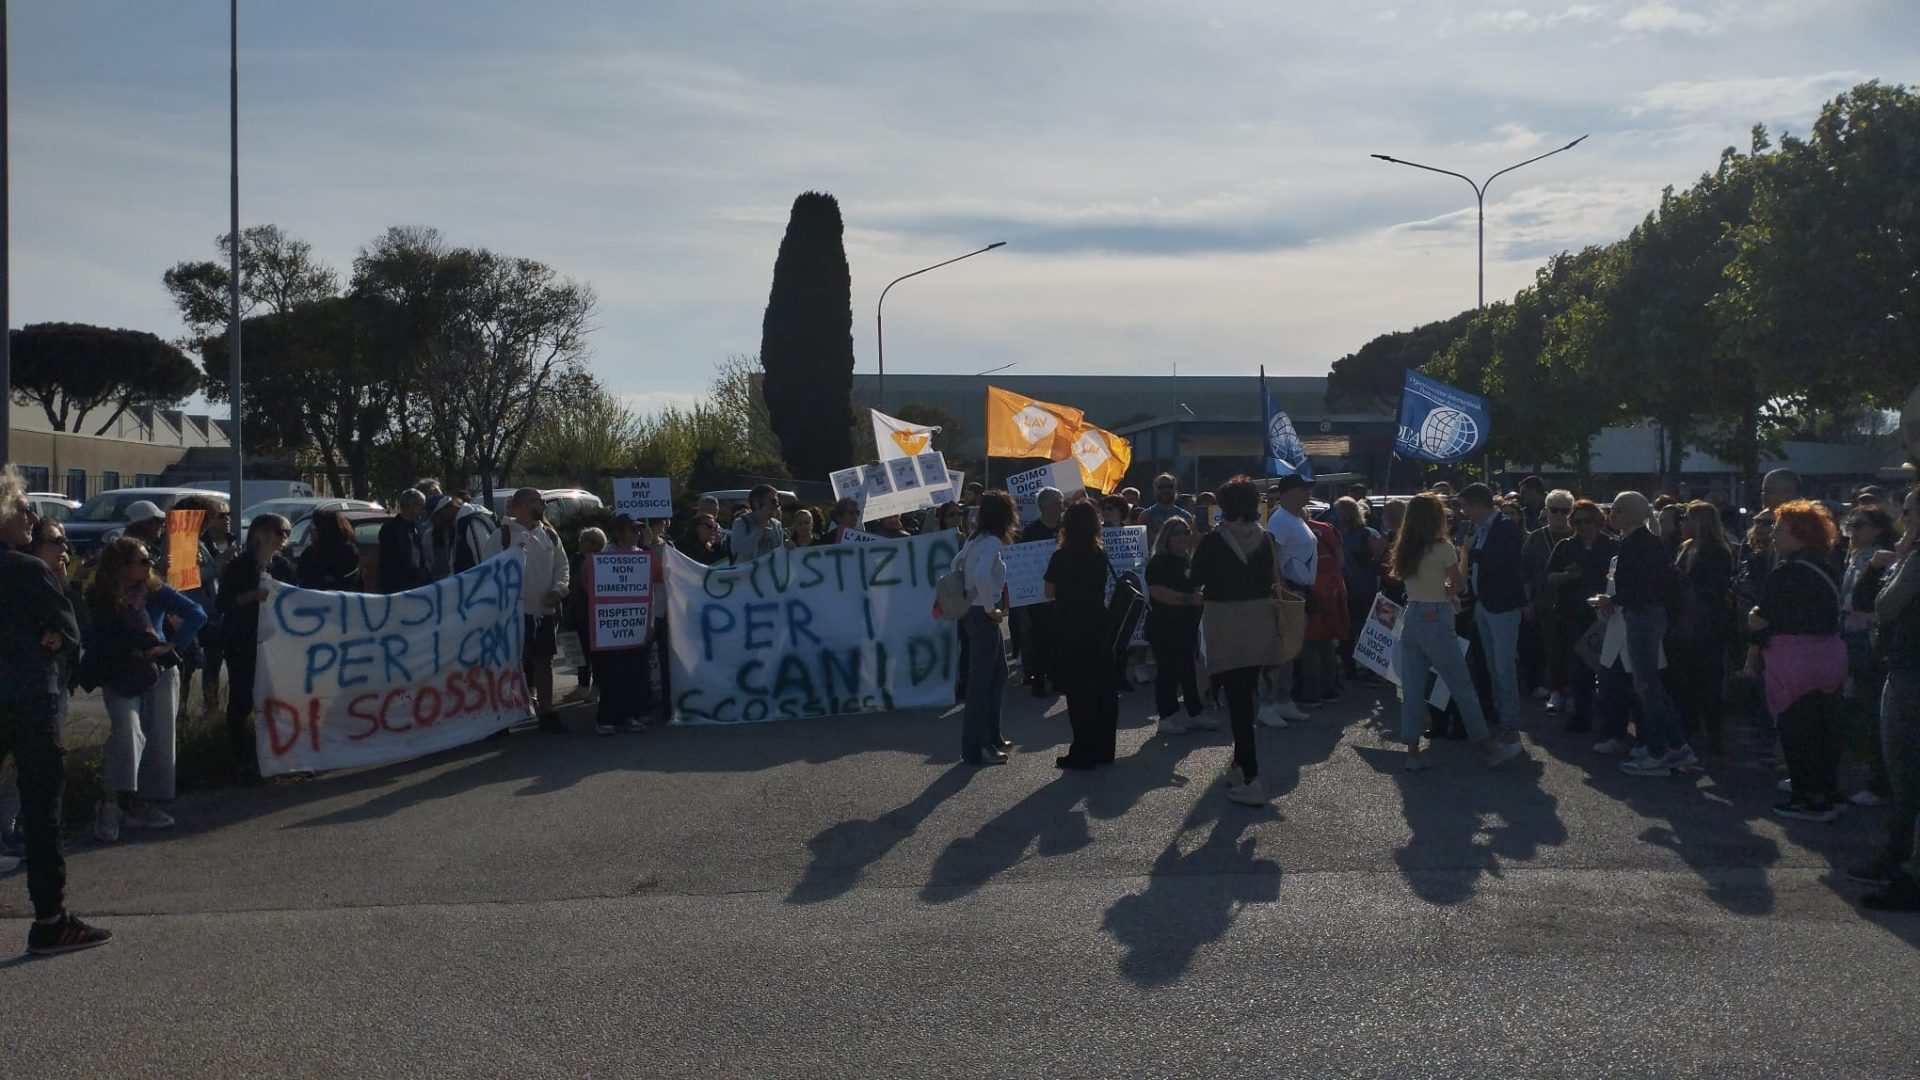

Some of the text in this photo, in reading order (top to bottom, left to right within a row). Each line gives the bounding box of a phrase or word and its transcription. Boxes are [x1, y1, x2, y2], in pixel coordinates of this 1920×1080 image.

[1023, 415, 1048, 428] LAV
[1010, 467, 1047, 486] OSIMO
[631, 481, 650, 489] MAI
[1016, 479, 1043, 494] DICE
[617, 500, 670, 509] SCOSSICCI
[1102, 529, 1139, 538] OGLIAMO
[1105, 537, 1137, 545] IUSTIZIA
[597, 556, 648, 565] SCOSSICCI
[612, 566, 634, 574] NON
[703, 539, 952, 599] GIUSTIZIA
[619, 574, 628, 583] SI
[597, 583, 648, 593] DIMENTICA
[274, 559, 523, 636] GIUSTIZIA
[598, 607, 647, 619] RISPETTO
[863, 597, 875, 641] I
[599, 617, 646, 629] PER OGNI
[701, 599, 821, 661] PER
[1367, 638, 1385, 655] VOCE
[1374, 631, 1393, 647] LORO
[433, 631, 440, 675] I
[908, 632, 951, 687] DI
[305, 634, 412, 694] PER
[736, 640, 888, 699] CANI
[1375, 655, 1390, 669] NOI
[263, 697, 321, 756] DI
